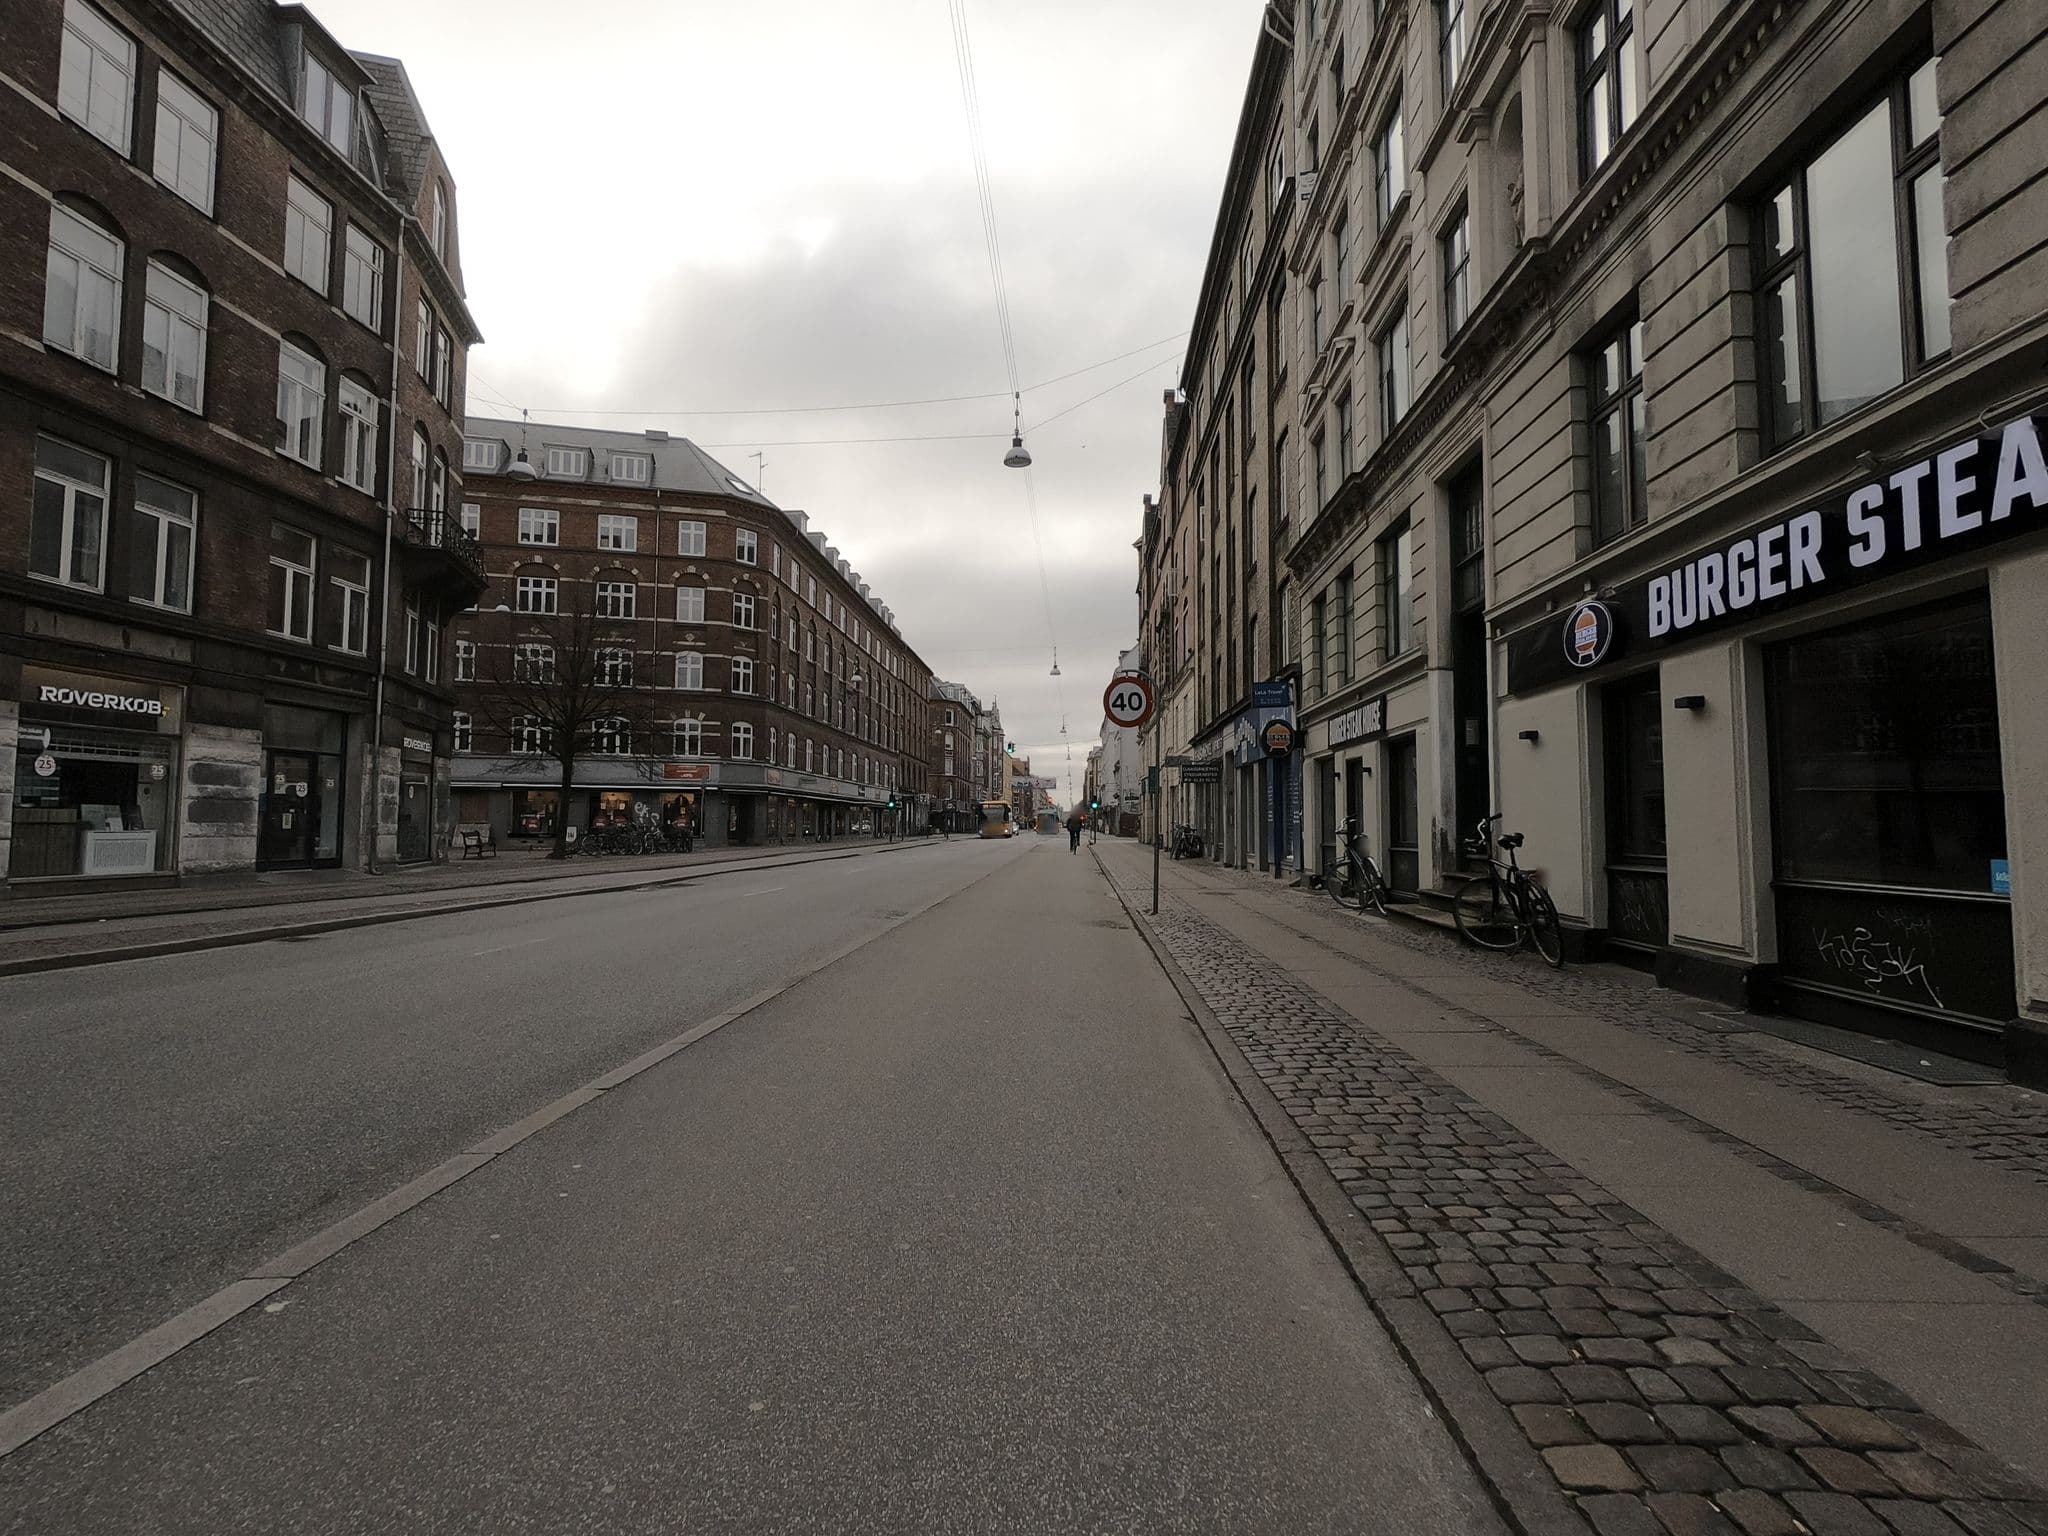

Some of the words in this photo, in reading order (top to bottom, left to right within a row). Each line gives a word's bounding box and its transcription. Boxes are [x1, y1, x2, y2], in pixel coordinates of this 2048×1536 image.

[1649, 510, 1825, 638] BURGER
[1847, 416, 2048, 568] STEA
[1112, 692, 1143, 711] 40
[39, 759, 52, 769] 25
[152, 765, 164, 774] 25
[297, 784, 306, 792] 25
